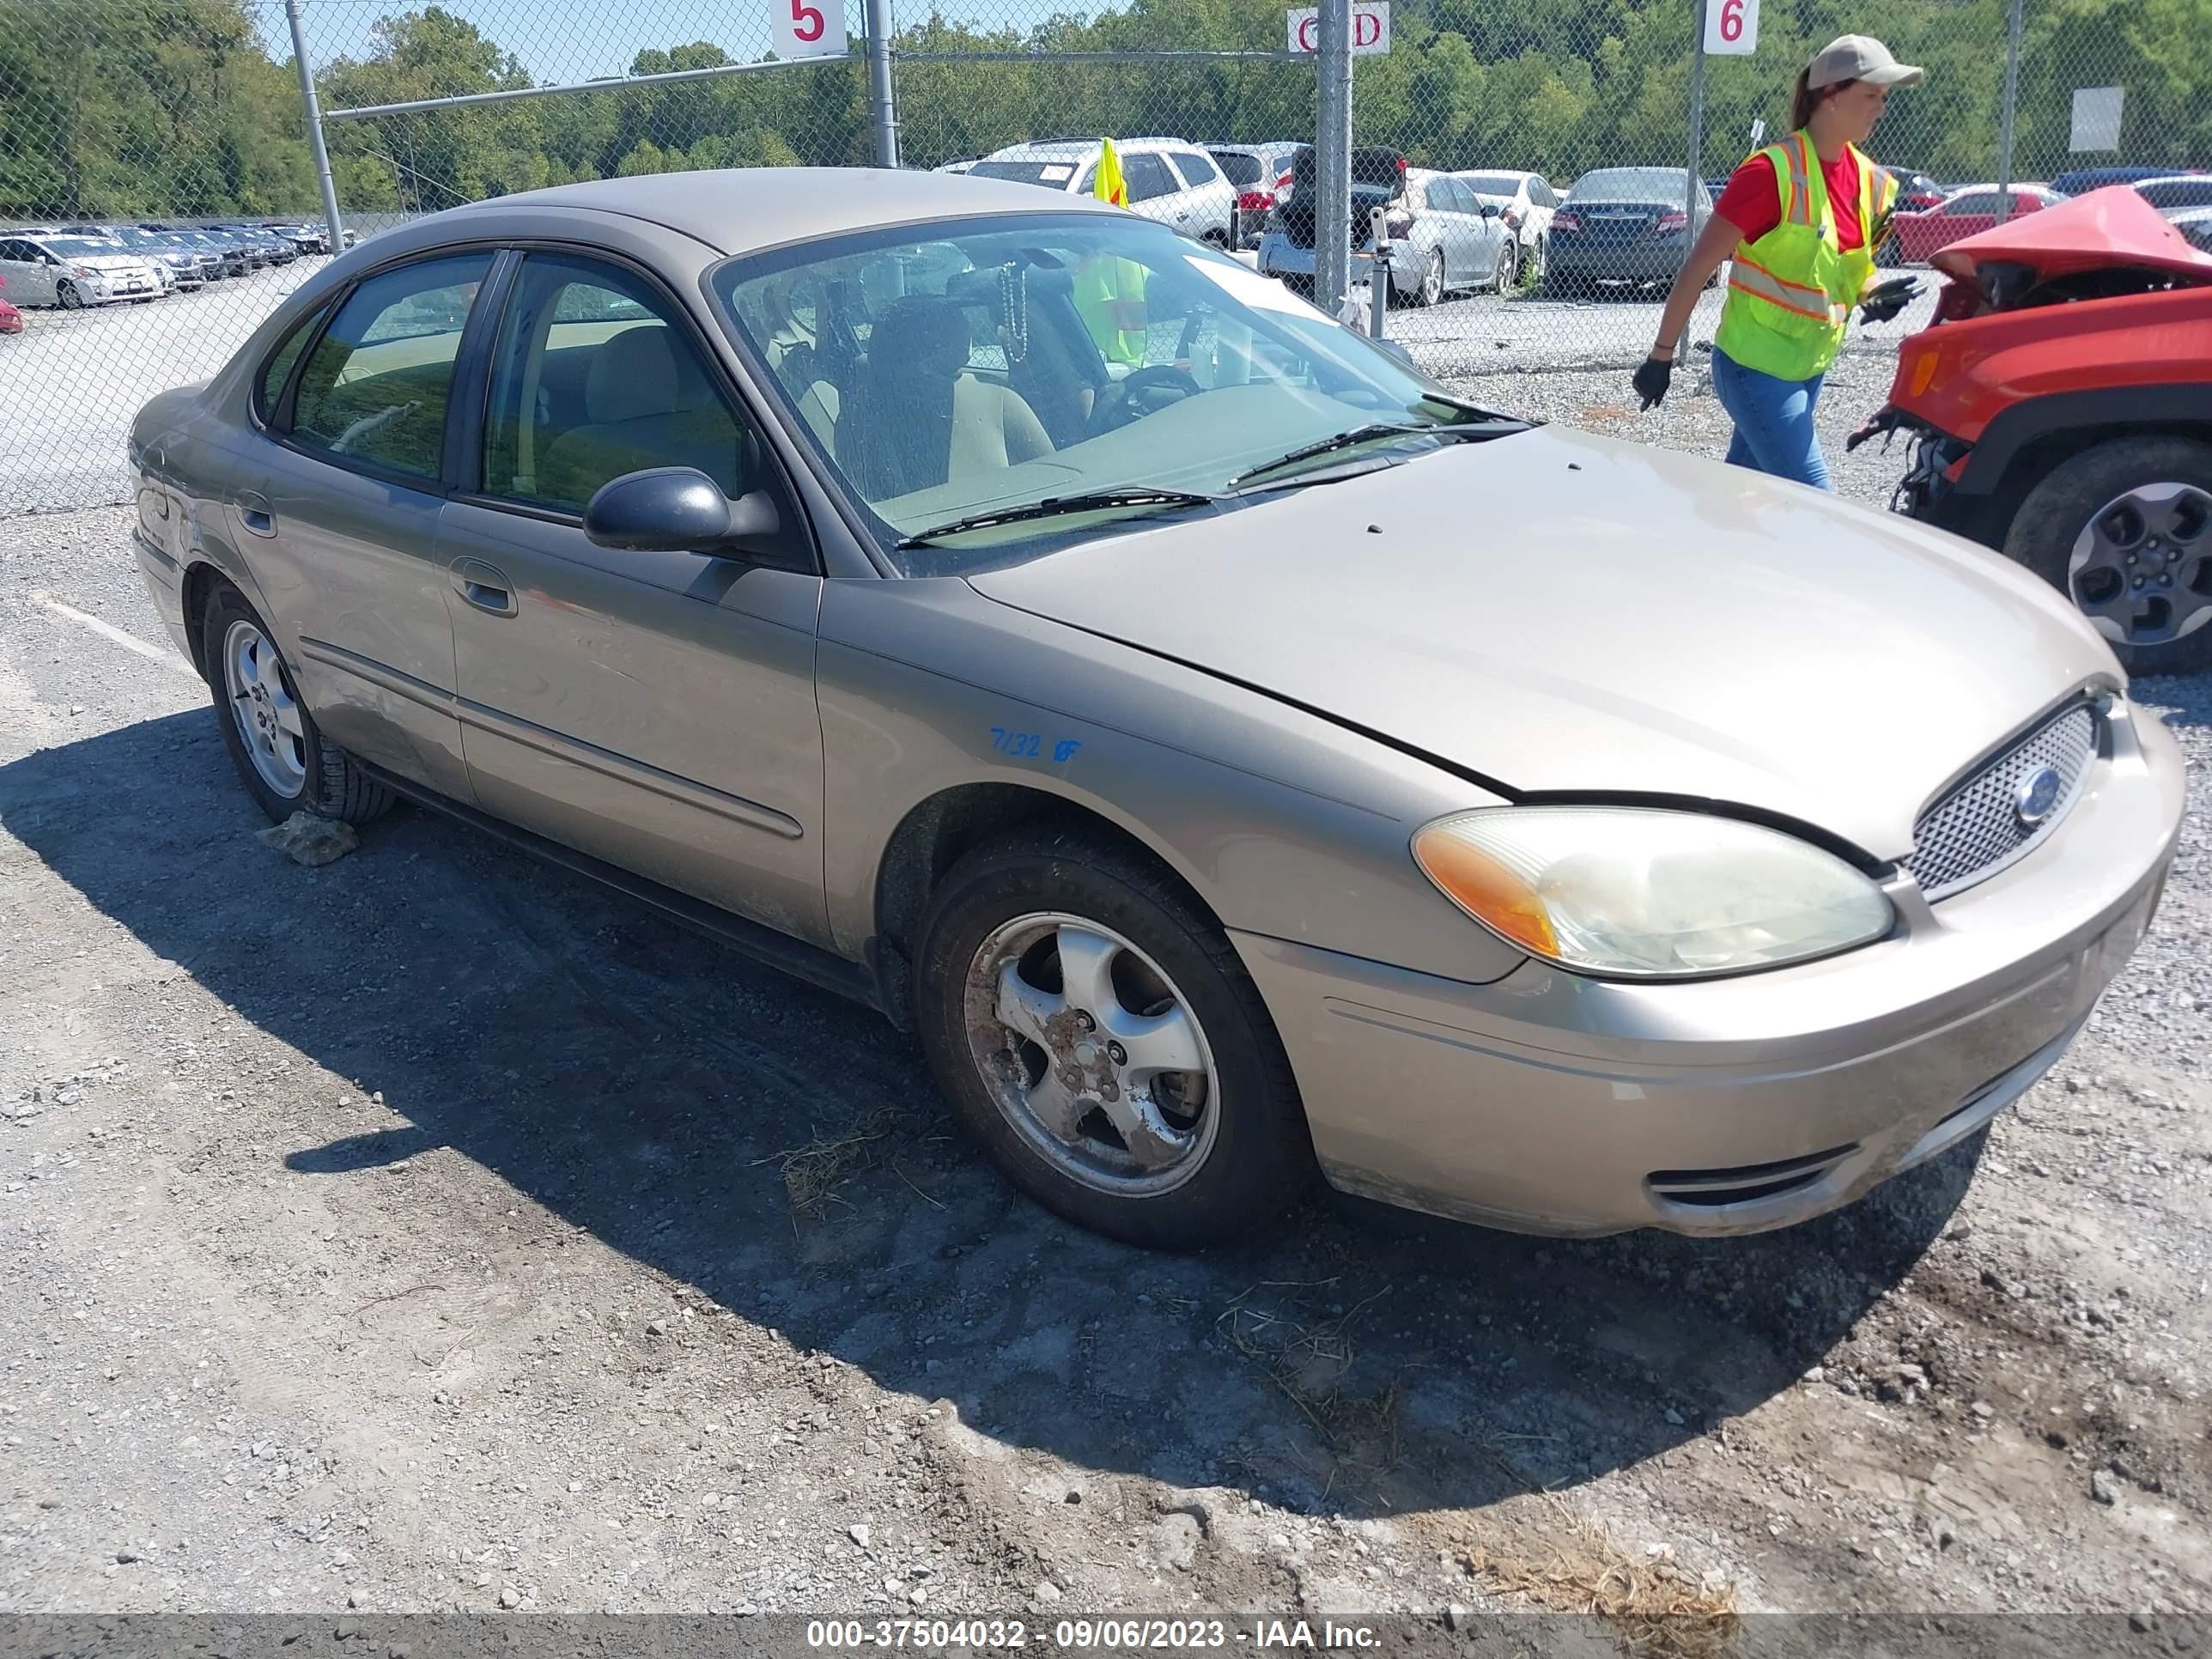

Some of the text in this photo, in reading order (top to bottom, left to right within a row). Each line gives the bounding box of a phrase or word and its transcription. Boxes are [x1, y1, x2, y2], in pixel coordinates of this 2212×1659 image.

[791, 0, 825, 42] 5
[1720, 0, 1744, 42] 6
[989, 726, 1042, 757] 7132
